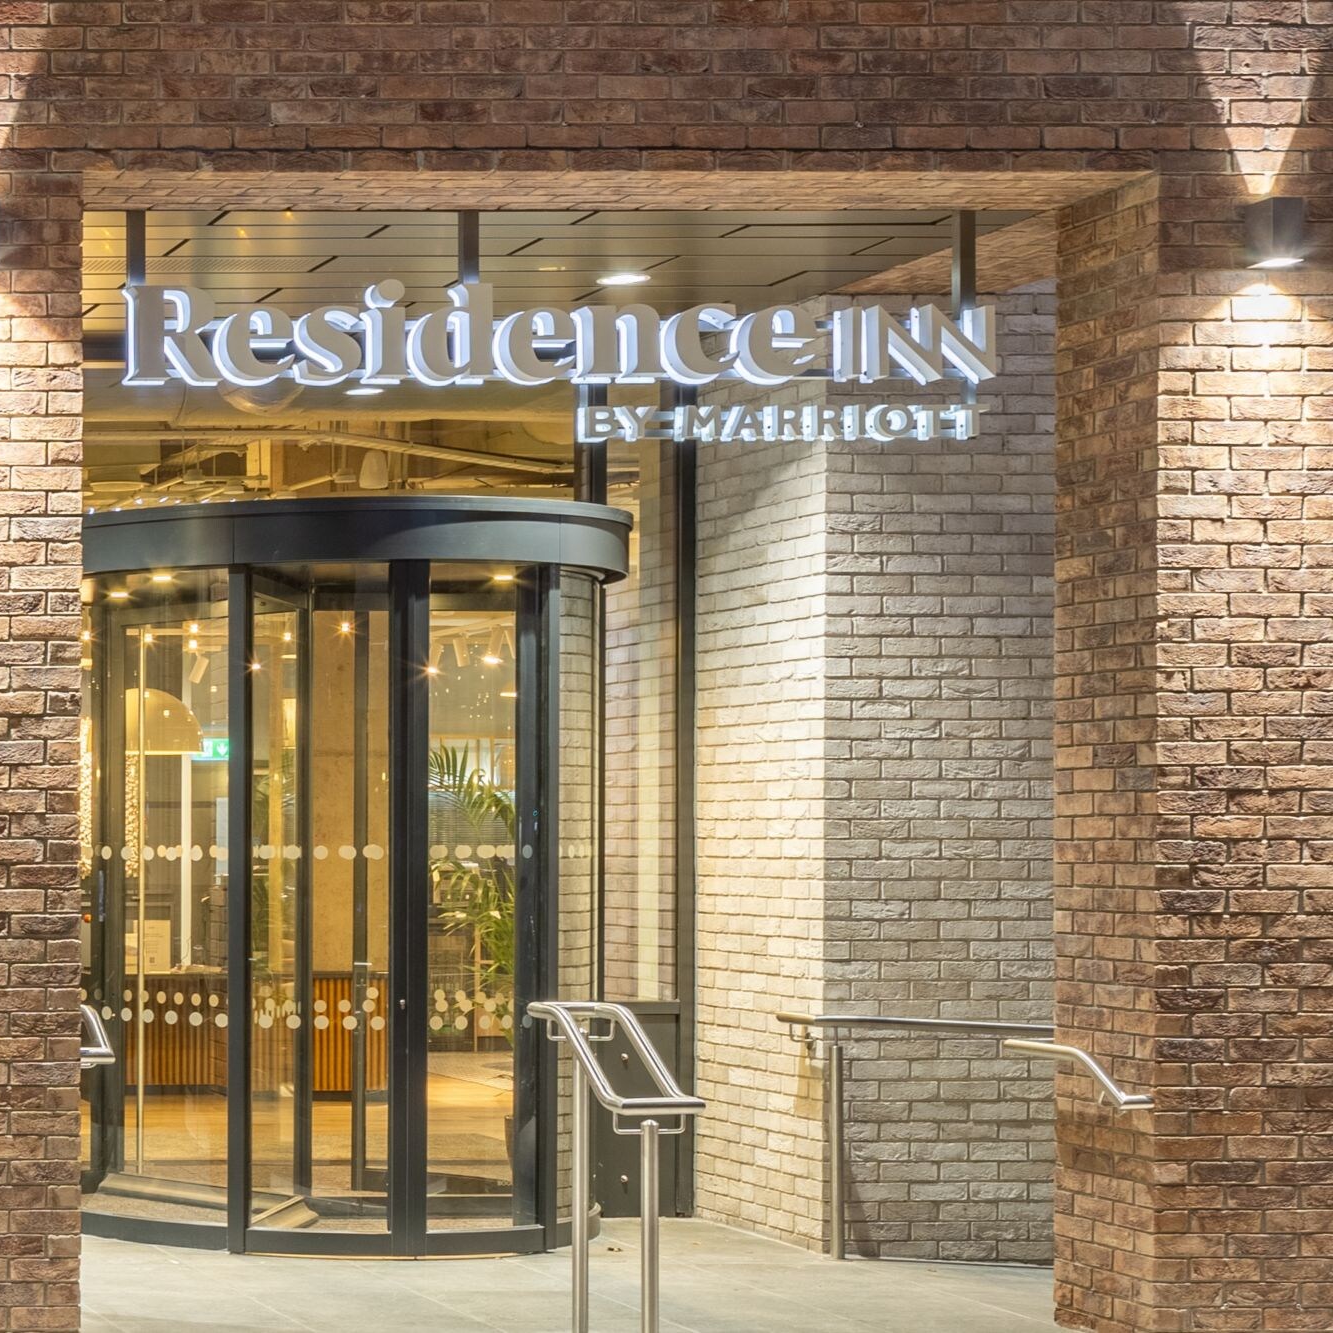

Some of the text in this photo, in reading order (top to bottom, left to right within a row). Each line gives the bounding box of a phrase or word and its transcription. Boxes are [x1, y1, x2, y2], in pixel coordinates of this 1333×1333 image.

[122, 279, 996, 386] Residence INN
[577, 403, 990, 443] BY MARRIOTT
